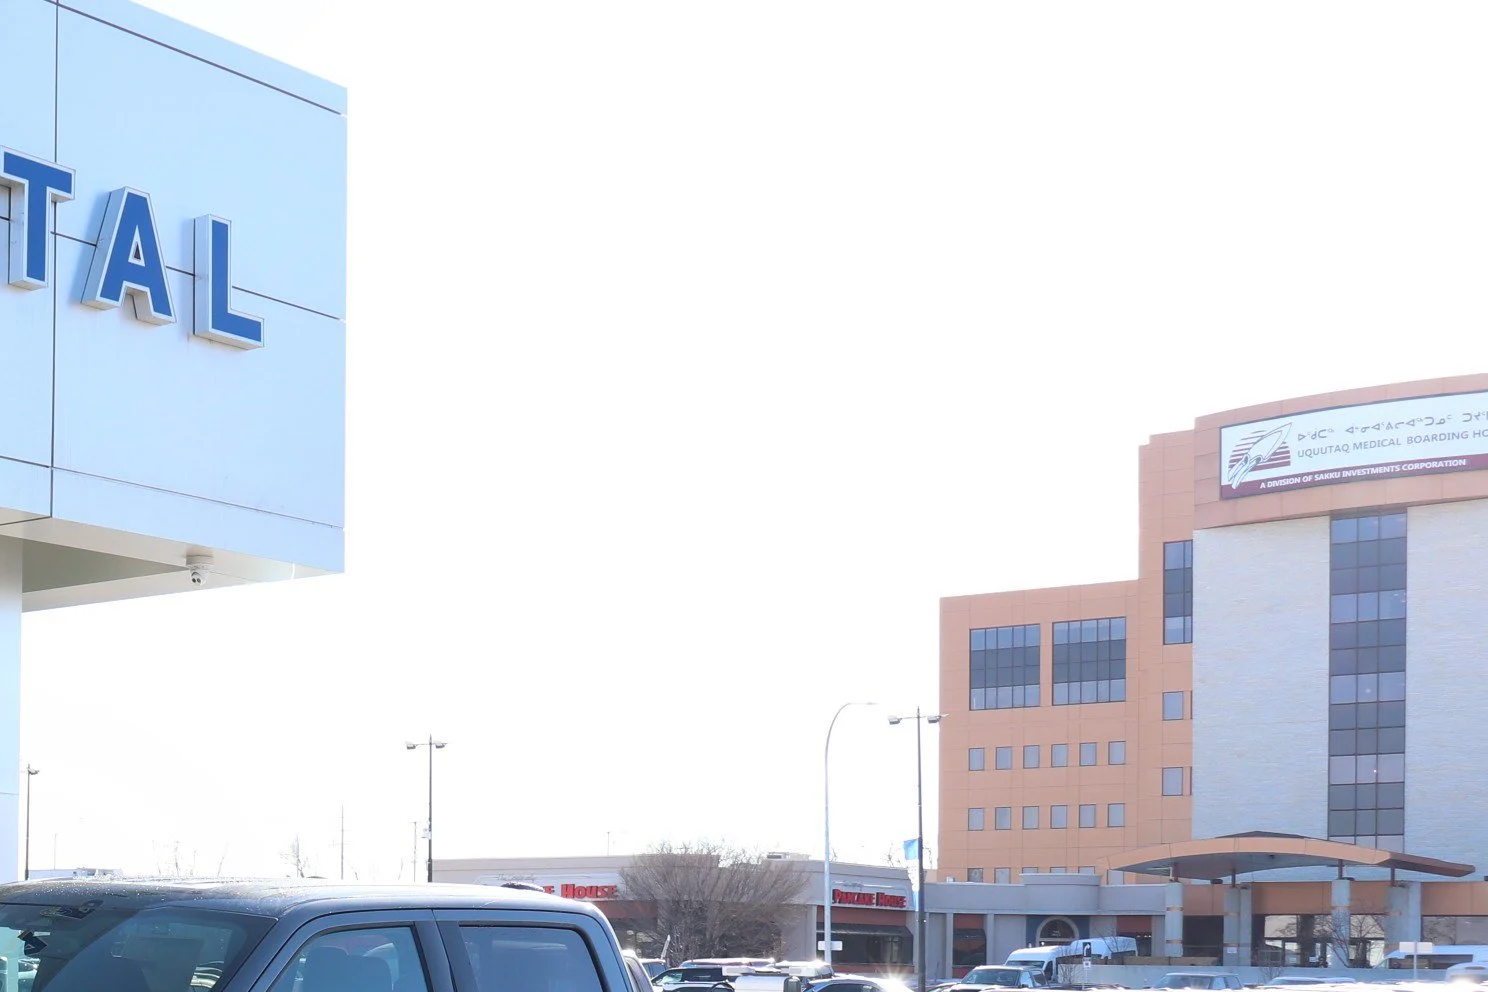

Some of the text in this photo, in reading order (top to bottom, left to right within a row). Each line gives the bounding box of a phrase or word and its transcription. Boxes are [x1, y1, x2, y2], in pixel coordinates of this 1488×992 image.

[1298, 443, 1351, 458] UQUUTAQ
[1352, 437, 1402, 451] MEDICAL
[1406, 430, 1469, 445] BOARDING
[1267, 477, 1301, 488] DIVISION
[1314, 471, 1341, 481] SAKKU
[1341, 464, 1401, 478] INVESTMENTS
[1401, 458, 1466, 471] CORPORATION
